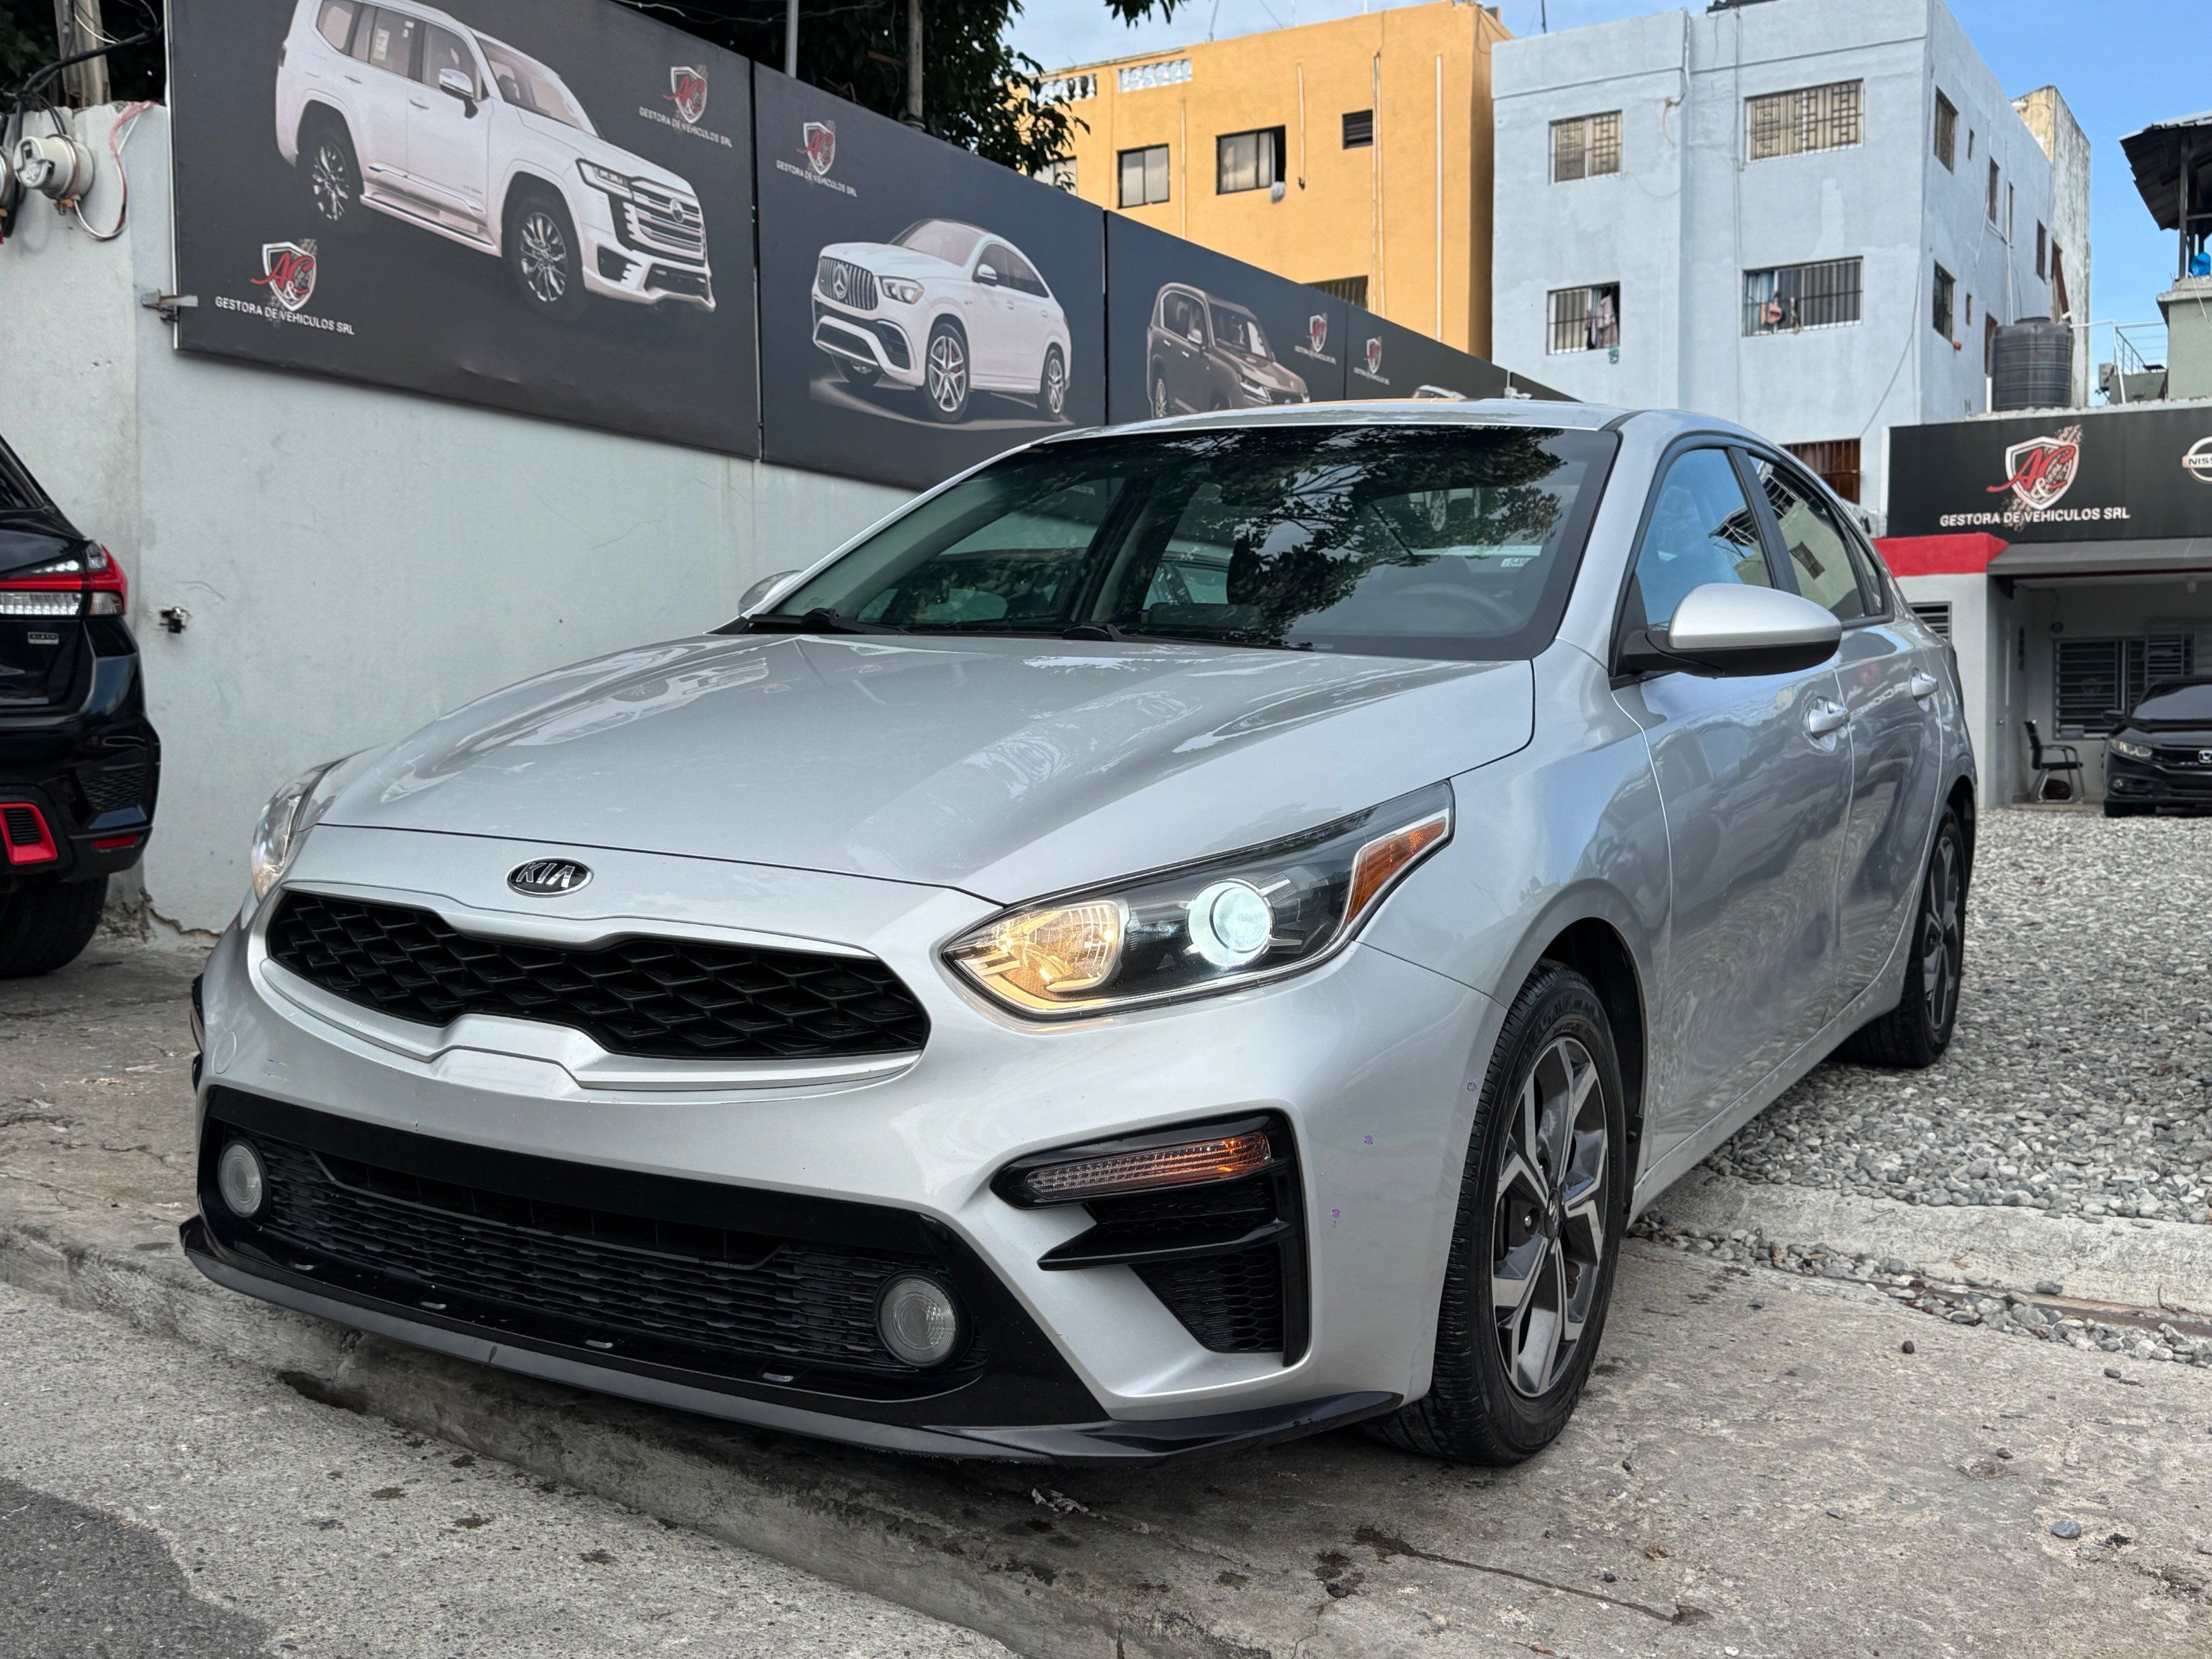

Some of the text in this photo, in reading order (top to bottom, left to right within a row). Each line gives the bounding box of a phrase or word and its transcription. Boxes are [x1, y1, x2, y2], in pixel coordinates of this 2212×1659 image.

[638, 106, 733, 148] GESTORA DE VEHICULOS SRL
[215, 296, 355, 335] GESTORA DE VEHICULOS SRL
[1940, 507, 2130, 527] GESTORA DE VEHICULOS SRL
[515, 861, 576, 888] KIA
